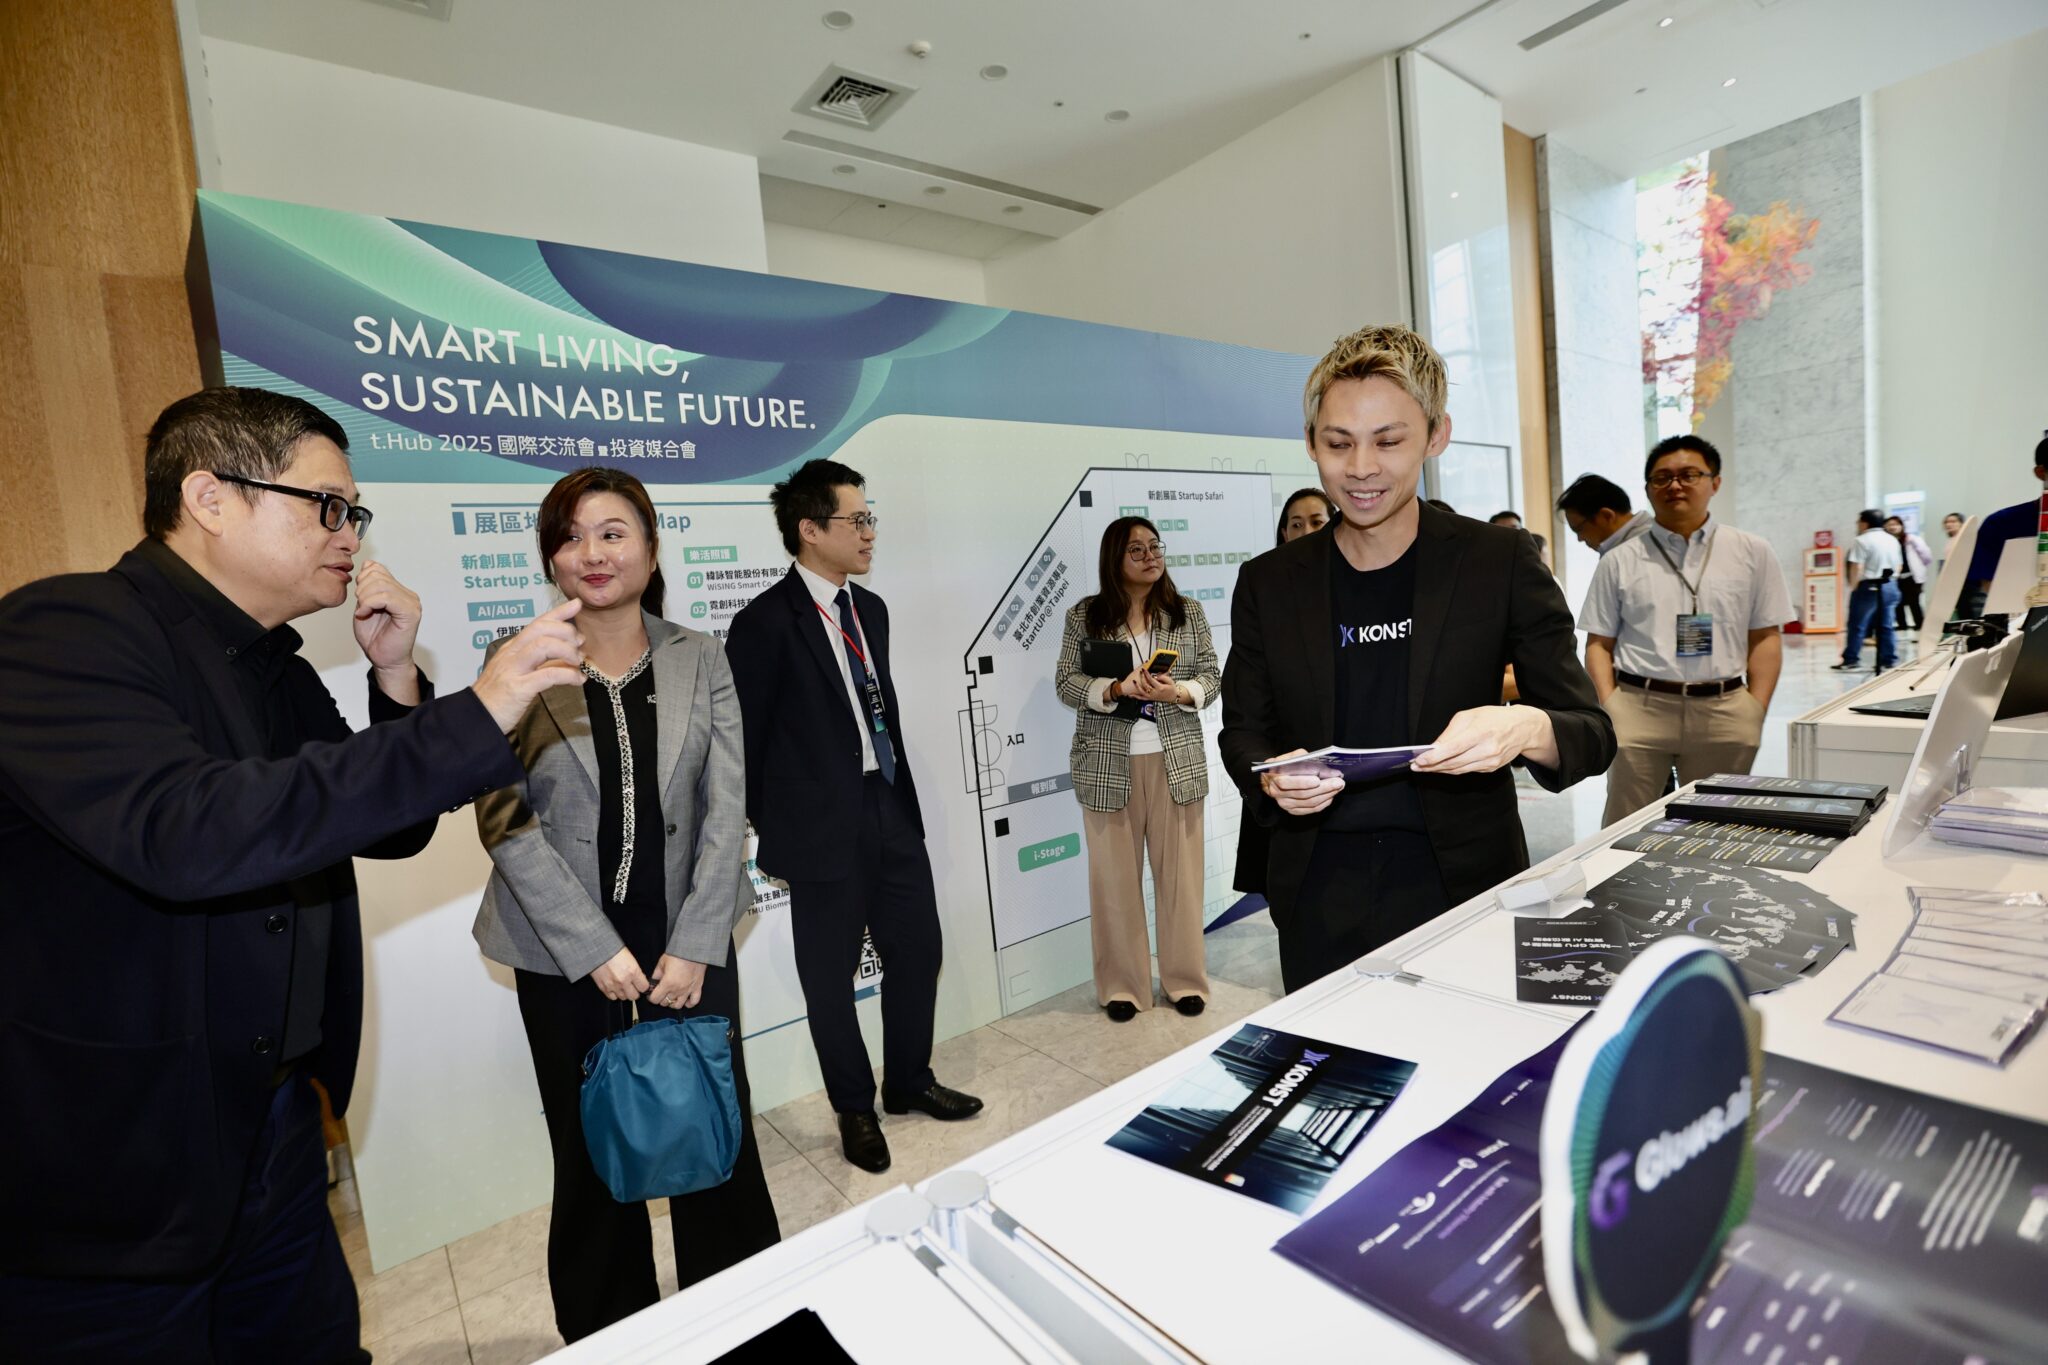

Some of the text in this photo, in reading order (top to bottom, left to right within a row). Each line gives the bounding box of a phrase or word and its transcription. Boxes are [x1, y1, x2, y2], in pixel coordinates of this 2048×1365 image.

[353, 315, 690, 384] SMART LIVING,
[361, 372, 816, 430] SUSTAINABLE FUTURE.
[370, 433, 432, 451] t.Hub
[438, 434, 492, 452] 2025
[1148, 490, 1224, 502] 新創展區 Startup Safari
[461, 553, 529, 570] 新創展區
[464, 574, 529, 589] Startup
[690, 567, 790, 585] 01 緯詠智能股份有限公
[707, 583, 736, 591] WiSING
[737, 580, 760, 589] Smart
[477, 604, 526, 618] AI/AIoT
[693, 606, 705, 614] 02
[711, 612, 736, 621] Ninno
[1022, 579, 1070, 651] StartUP@Taipei
[1007, 733, 1025, 746] 入口
[1033, 845, 1066, 861] i-Stage
[1262, 1063, 1313, 1107] KONST
